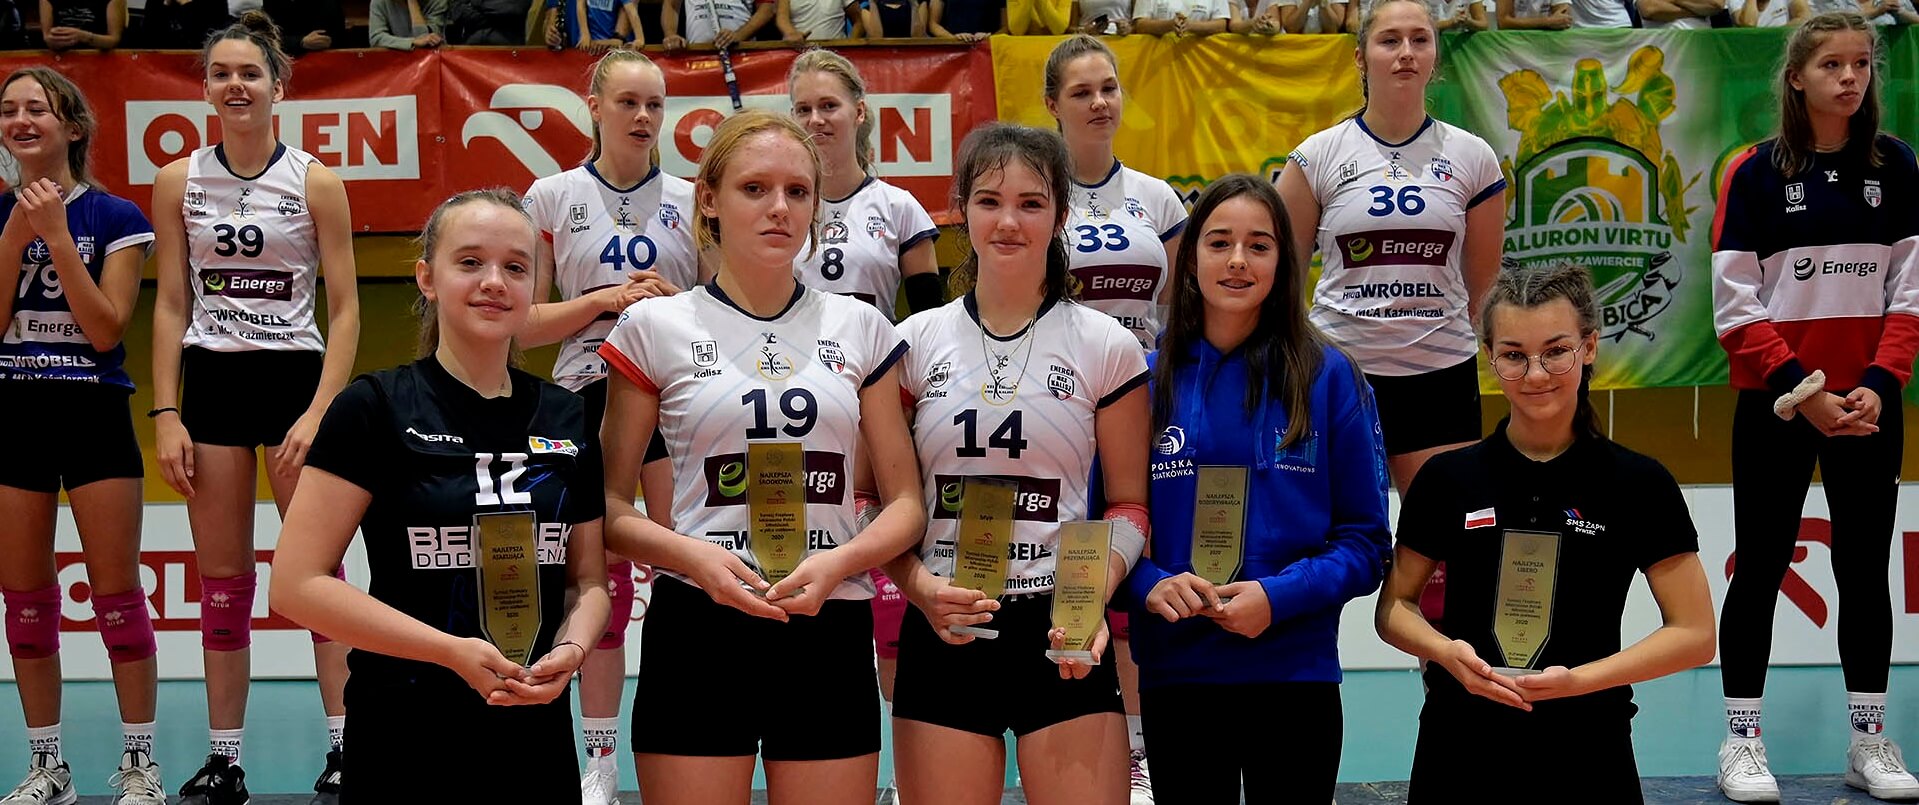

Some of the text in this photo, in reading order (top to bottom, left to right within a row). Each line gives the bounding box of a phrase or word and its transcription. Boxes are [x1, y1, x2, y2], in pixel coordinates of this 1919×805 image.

[143, 110, 398, 169] OEN
[1367, 185, 1426, 217] 36
[1786, 205, 1807, 213] Kalisz
[570, 225, 590, 233] Kalisz
[213, 224, 264, 258] 39
[1075, 224, 1130, 253] 33
[1503, 227, 1671, 252] ALURON VIRTU
[599, 235, 657, 271] 40
[1382, 240, 1444, 258] Energa
[820, 247, 844, 281] 8
[1575, 256, 1644, 268] ZAWIERCIE
[1822, 261, 1877, 277] Energa
[19, 263, 64, 299] 79
[230, 276, 286, 293] Energa
[1092, 275, 1152, 293] Energa
[1361, 280, 1444, 298] WRÓBEL
[217, 309, 291, 327] WRÓBEL
[1603, 294, 1662, 327] BICA
[28, 320, 82, 336] Energa
[13, 353, 95, 368] WRÓBEL
[693, 369, 722, 379] Kalisz
[1050, 365, 1075, 376] ENERGA
[926, 390, 947, 398] Kalisz
[1051, 380, 1072, 392] KALISZ
[742, 387, 818, 439] 19
[953, 409, 1027, 459] 14
[1152, 459, 1194, 471] POLSKA
[475, 453, 531, 505] 12
[1152, 469, 1195, 480] SIATKÓWKA
[1566, 519, 1584, 527] SMS
[1006, 571, 1056, 589] miercza
